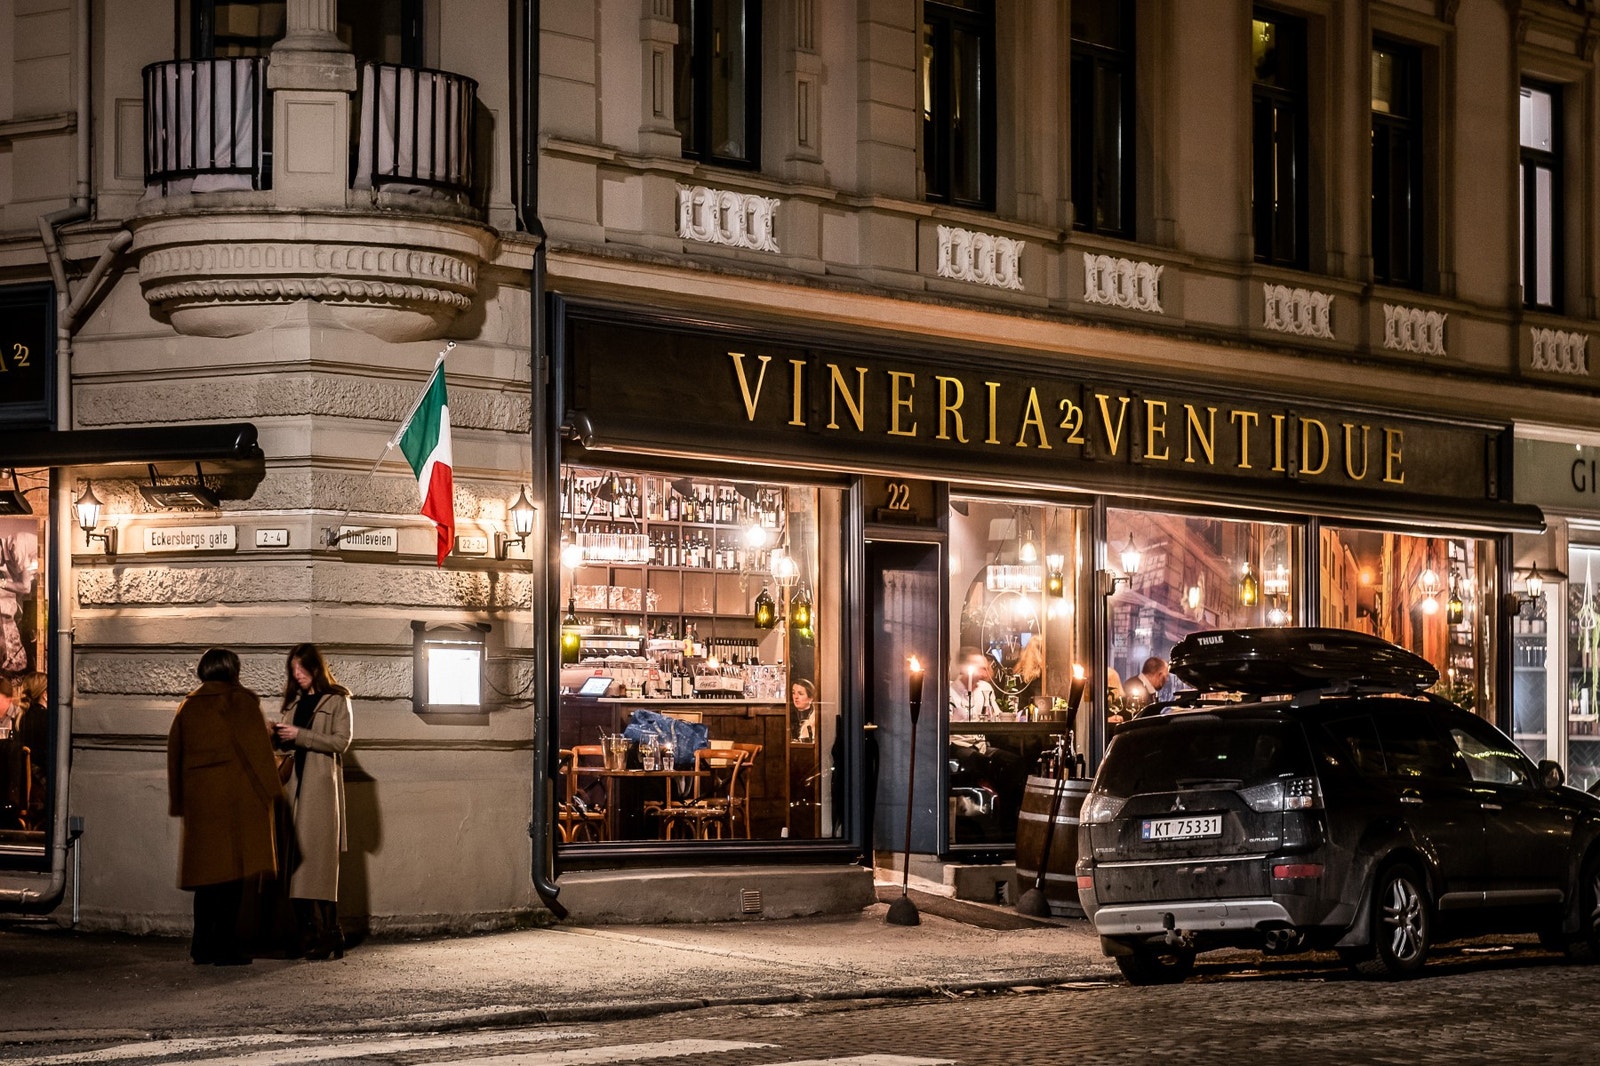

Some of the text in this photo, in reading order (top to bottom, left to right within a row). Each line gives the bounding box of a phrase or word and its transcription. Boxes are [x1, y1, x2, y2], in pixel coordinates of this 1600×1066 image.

[13, 343, 30, 367] 22
[727, 352, 1405, 484] VINERIA 22 VENTIDUE
[888, 483, 910, 510] 22
[151, 531, 228, 549] Eckersbergs gate
[346, 529, 392, 547] Gimleveien
[1197, 635, 1224, 646] THULE
[1154, 818, 1217, 837] KT 75331
